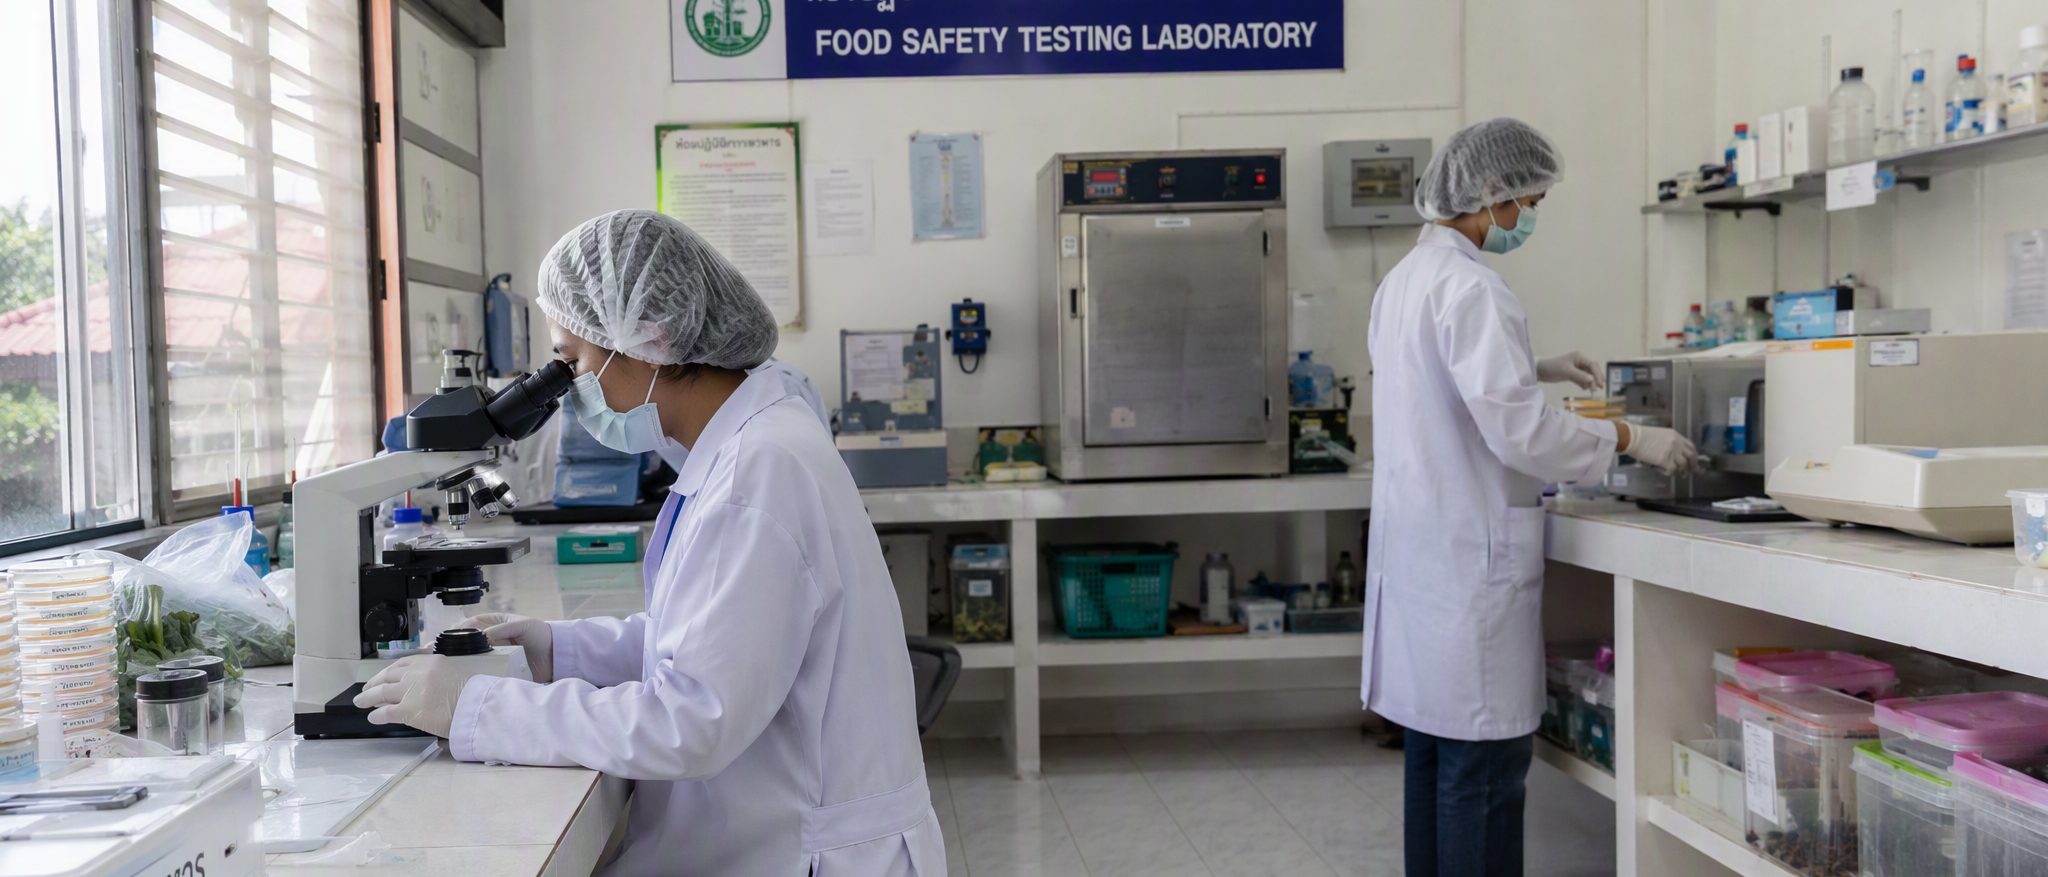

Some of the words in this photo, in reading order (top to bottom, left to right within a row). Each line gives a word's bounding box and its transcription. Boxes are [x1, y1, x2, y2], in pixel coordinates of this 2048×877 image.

[816, 29, 892, 56] FOOD
[902, 27, 1008, 55] SAFETY
[1018, 24, 1132, 53] TESTING
[1142, 21, 1318, 51] LABORATORY
